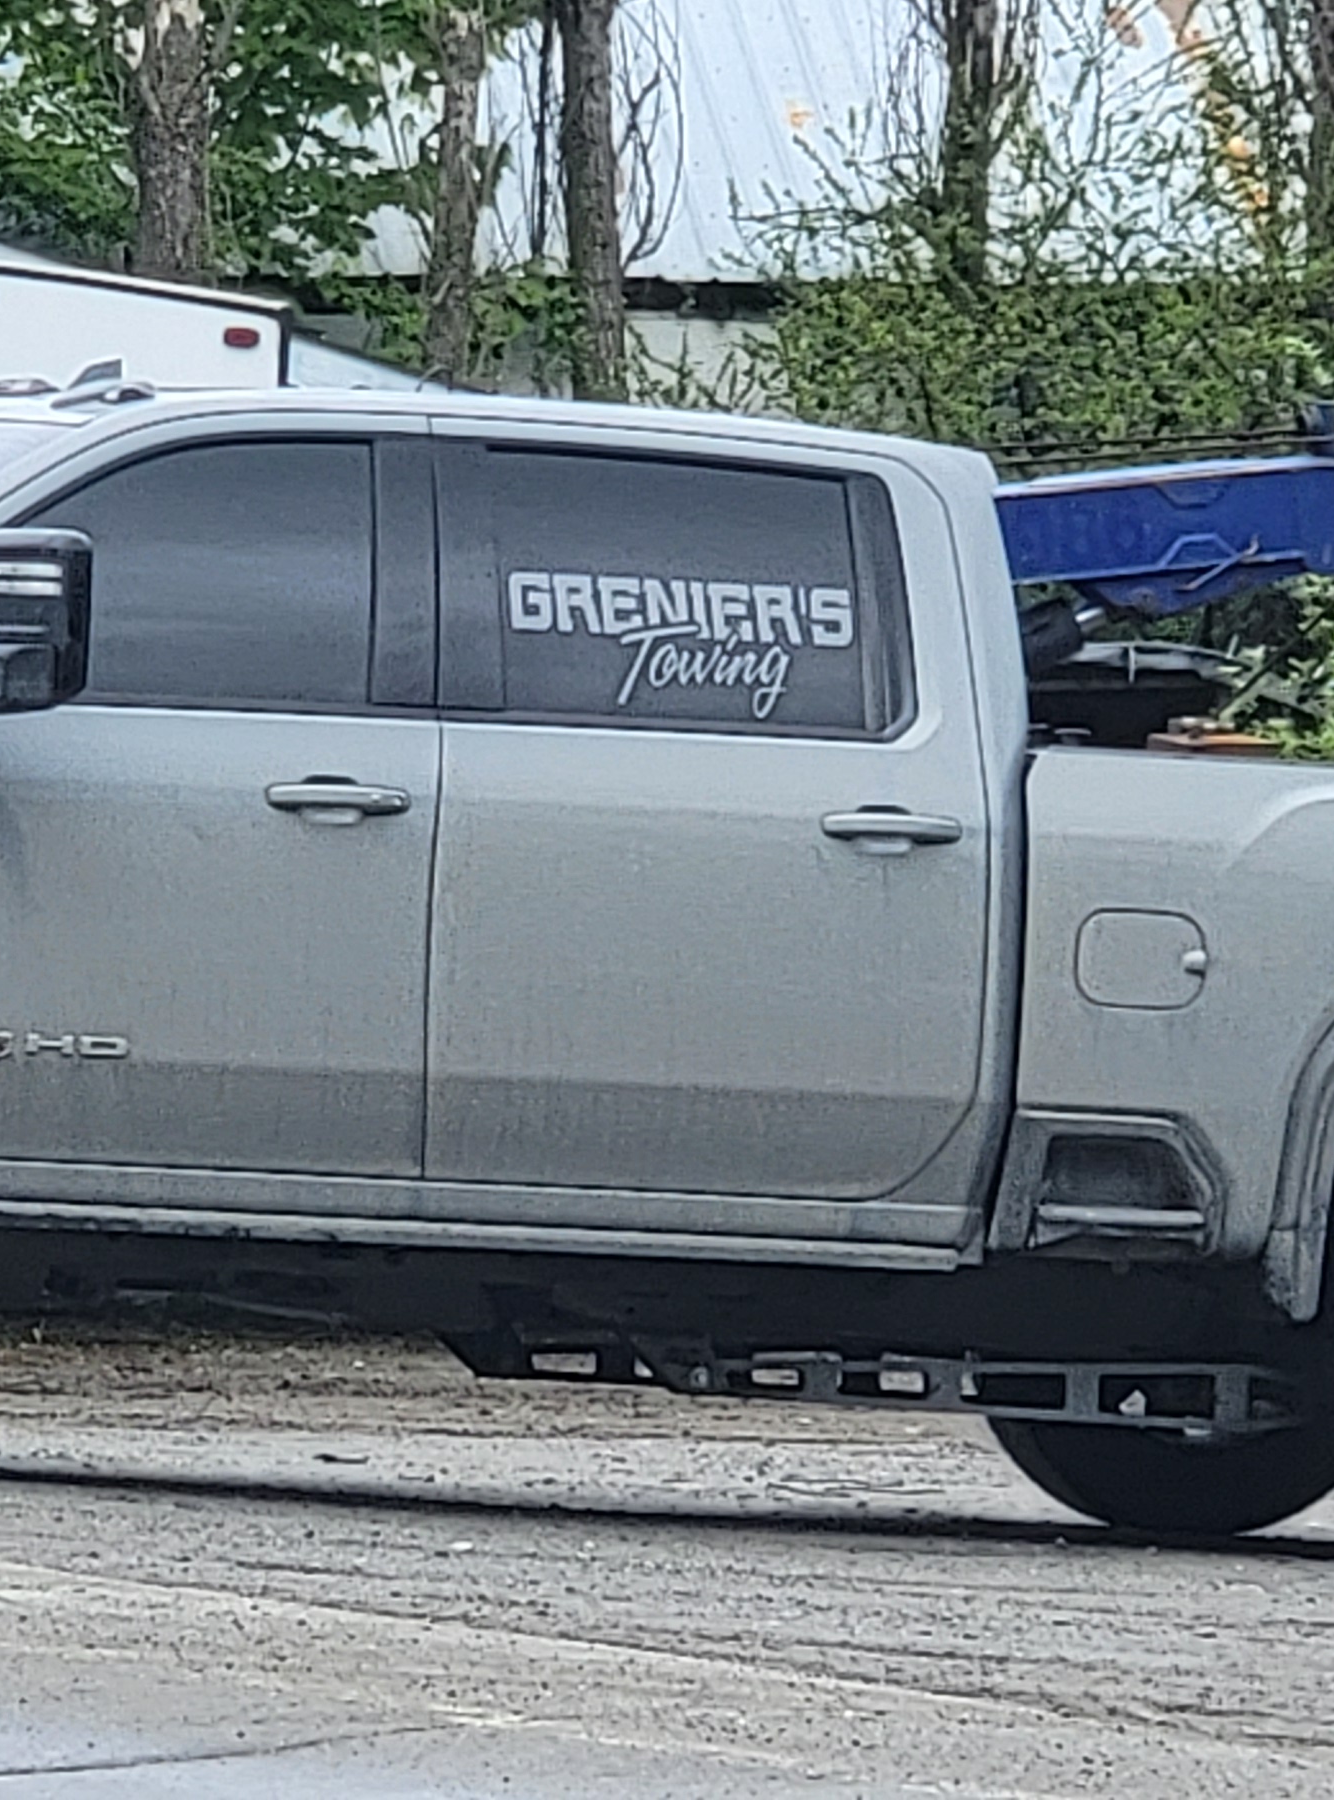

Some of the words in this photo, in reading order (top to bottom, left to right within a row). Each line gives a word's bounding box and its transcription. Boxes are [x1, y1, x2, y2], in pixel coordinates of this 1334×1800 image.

[508, 571, 854, 648] GRENIER'S
[616, 623, 791, 719] Towing
[25, 1033, 128, 1058] HD
